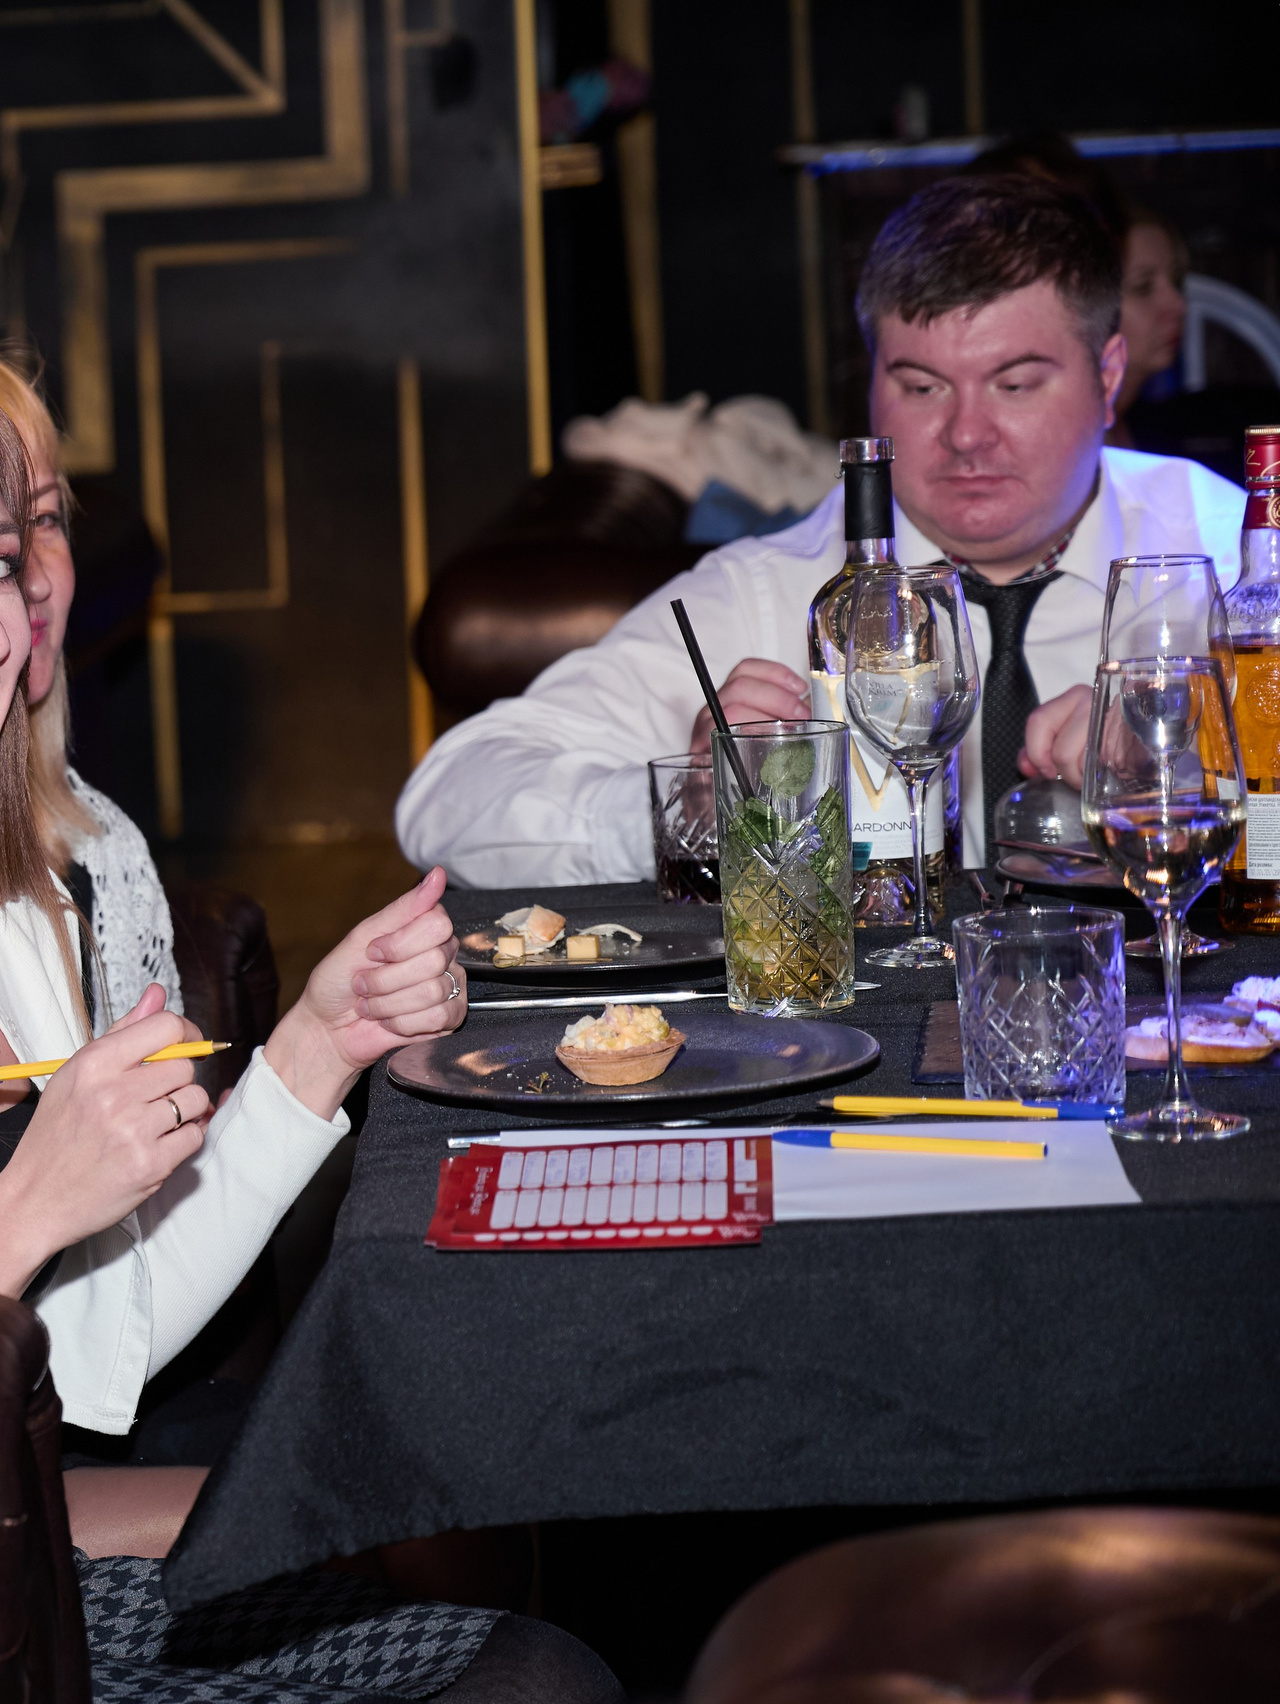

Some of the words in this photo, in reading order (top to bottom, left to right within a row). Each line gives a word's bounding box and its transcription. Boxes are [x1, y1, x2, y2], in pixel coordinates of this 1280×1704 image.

[868, 681, 893, 690] VILLA
[868, 687, 897, 697] KRIM
[853, 821, 913, 832] ARDONN
